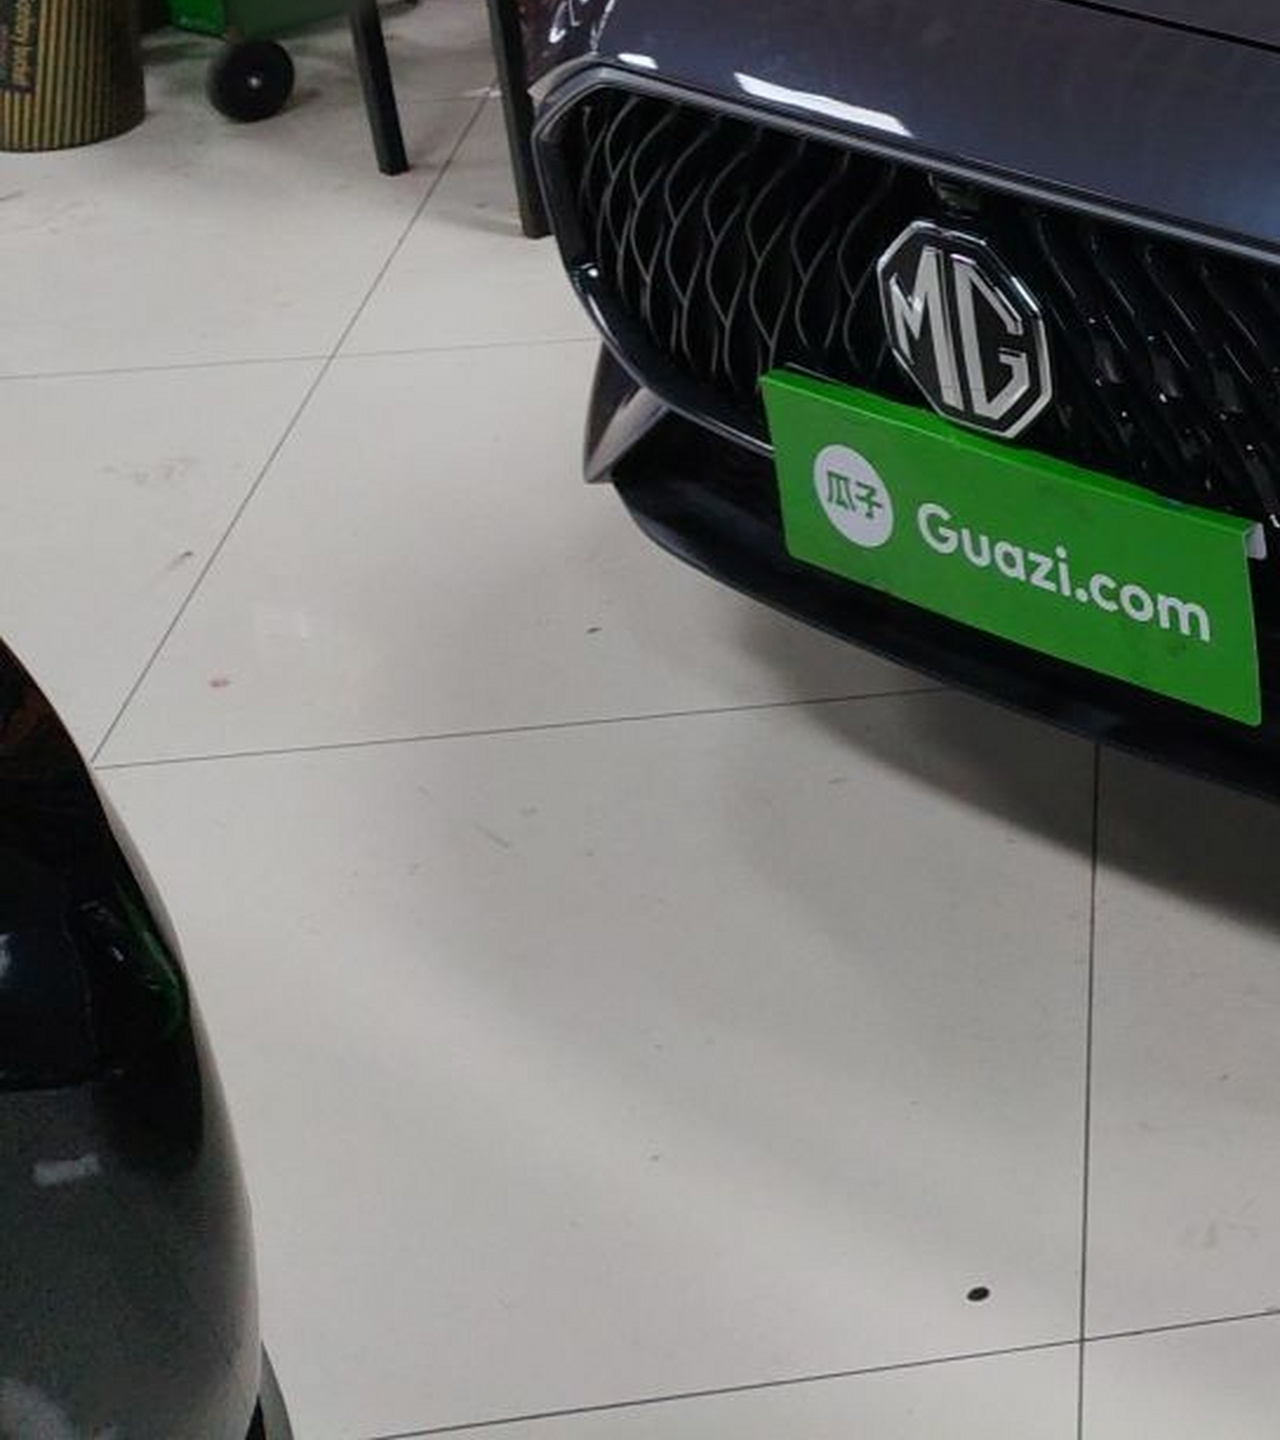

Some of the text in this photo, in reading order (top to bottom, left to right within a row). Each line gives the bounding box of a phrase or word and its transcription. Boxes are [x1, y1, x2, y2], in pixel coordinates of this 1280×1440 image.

[889, 245, 1031, 420] MG
[825, 469, 884, 520] 瓜子
[916, 502, 1212, 643] Guazi.com
